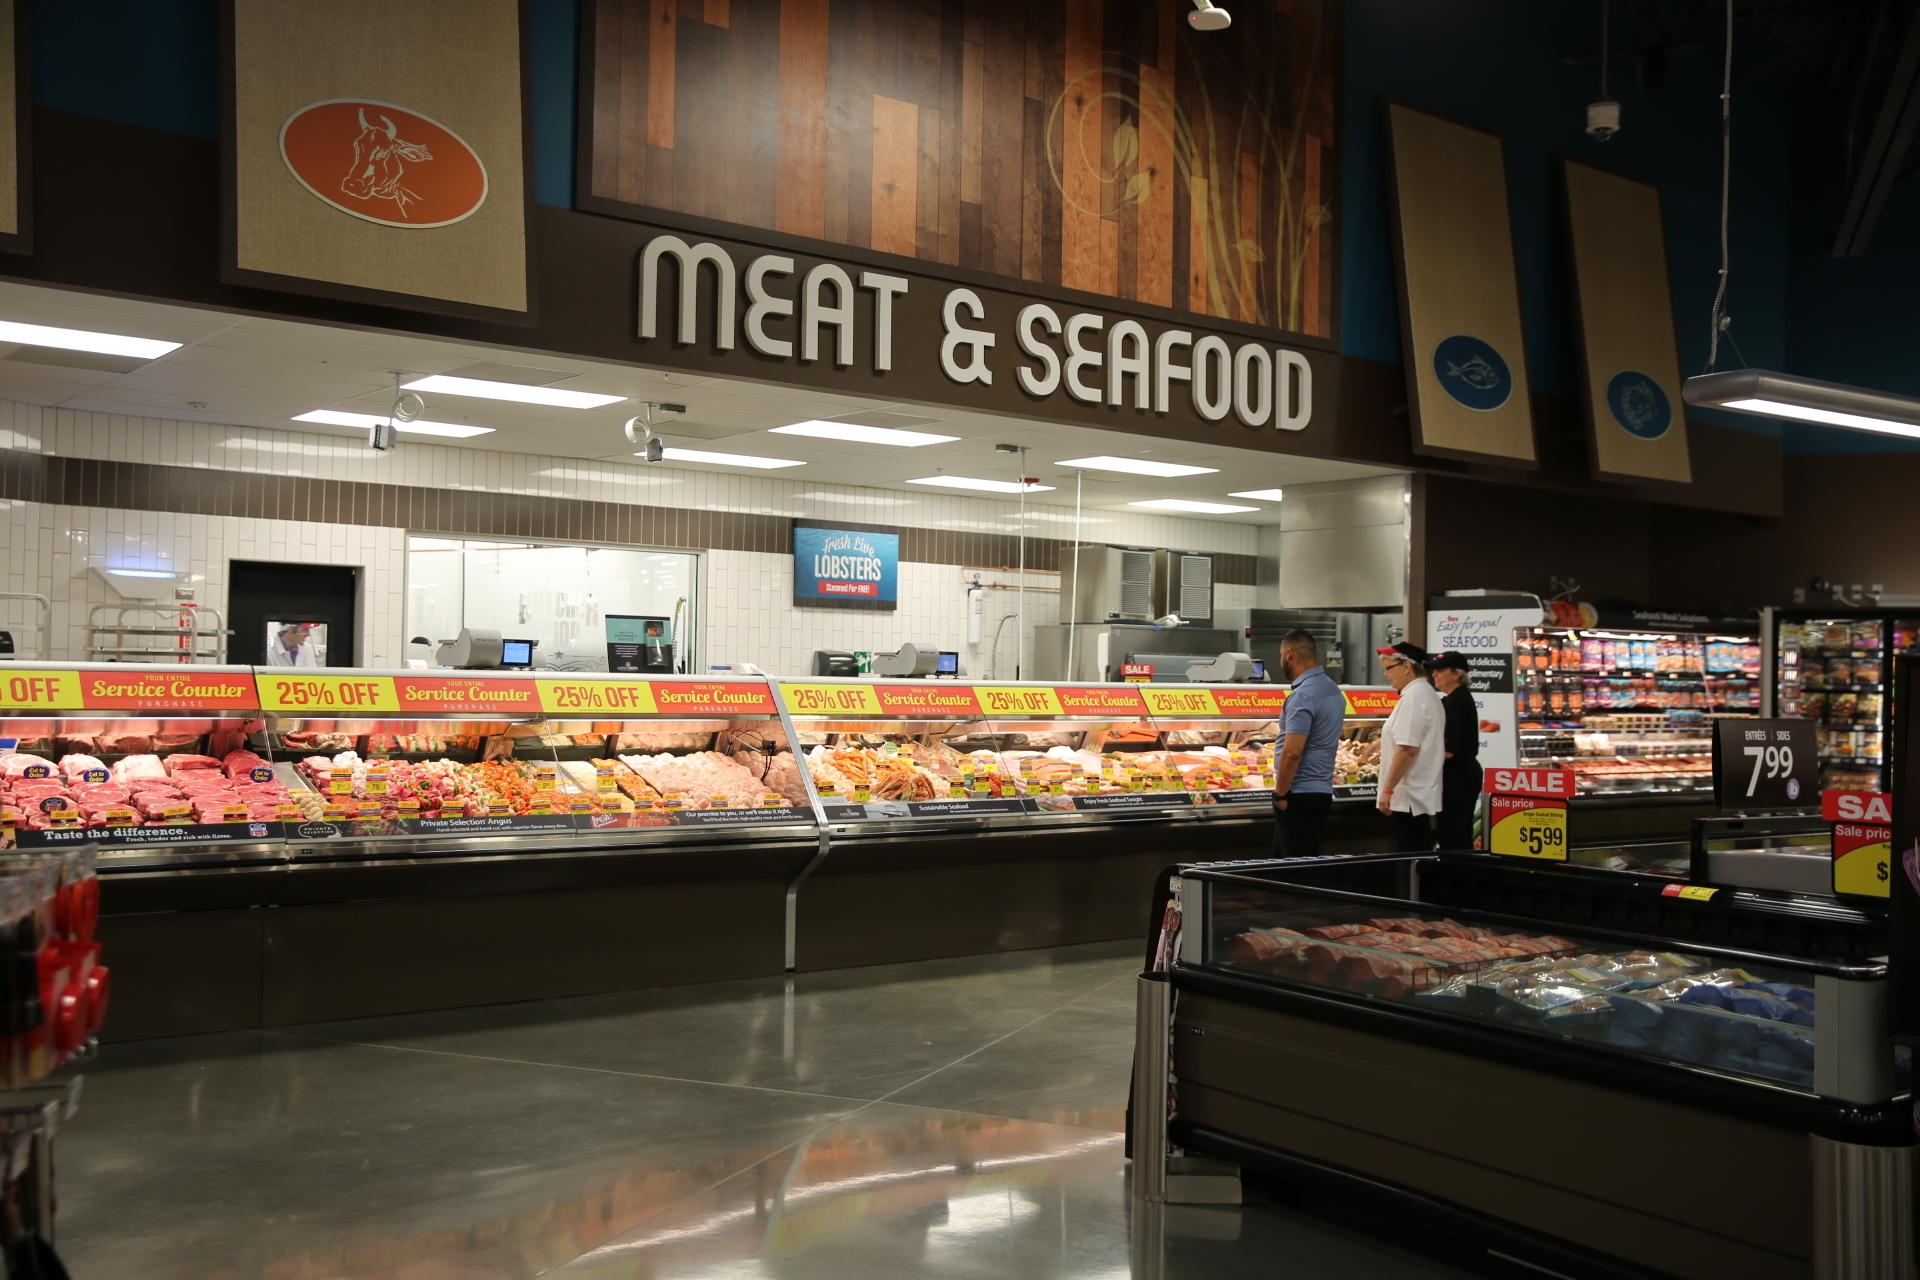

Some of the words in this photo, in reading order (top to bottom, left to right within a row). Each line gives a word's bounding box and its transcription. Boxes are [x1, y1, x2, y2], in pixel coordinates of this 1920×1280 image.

[638, 235, 908, 371] MEAT
[940, 288, 995, 386] &
[1015, 303, 1313, 431] SEAFOOD
[822, 534, 852, 554] Fresh
[853, 535, 876, 558] Live
[814, 554, 882, 581] LOBSTERS
[1436, 620, 1462, 635] Easy
[1460, 616, 1475, 634] for
[1474, 615, 1502, 634] you!
[1442, 636, 1498, 648] SEAFOOD
[1125, 665, 1150, 674] SALE
[9, 677, 61, 702] OFF
[92, 679, 165, 697] Service
[171, 681, 246, 698] Counter
[276, 681, 335, 705] 25%
[338, 682, 380, 705] OFF
[405, 685, 465, 701] Service
[469, 686, 531, 701] Counter
[1470, 682, 1490, 691] oday!
[553, 686, 602, 708] 25%
[604, 687, 640, 708] OFF
[660, 688, 710, 703] Service
[713, 690, 766, 704] Counter
[793, 689, 836, 709] 25%
[836, 690, 866, 709] OFF
[883, 692, 926, 705] Service
[927, 692, 972, 706] Counter
[986, 691, 1024, 710] 25%
[1023, 692, 1049, 710] OFF
[1063, 694, 1100, 706] Service
[1101, 694, 1139, 707] Counter
[1152, 694, 1185, 711] 25%
[1184, 694, 1208, 711] OFF
[1218, 695, 1250, 707] Service
[1352, 696, 1383, 708] Service
[1744, 728, 1767, 741] ENTRÉES
[1776, 730, 1791, 741] SIDES
[1494, 770, 1564, 792] SALE
[1790, 783, 1798, 794] lb
[1491, 797, 1510, 807] Sale
[1511, 799, 1535, 809] price
[1838, 795, 1891, 822] SA
[420, 819, 449, 827] Private
[488, 817, 513, 826] Angus
[44, 831, 83, 840] Taste
[87, 829, 110, 838] the
[113, 827, 188, 837] difference.
[1835, 824, 1862, 838] Sale
[1866, 826, 1891, 840] pric
